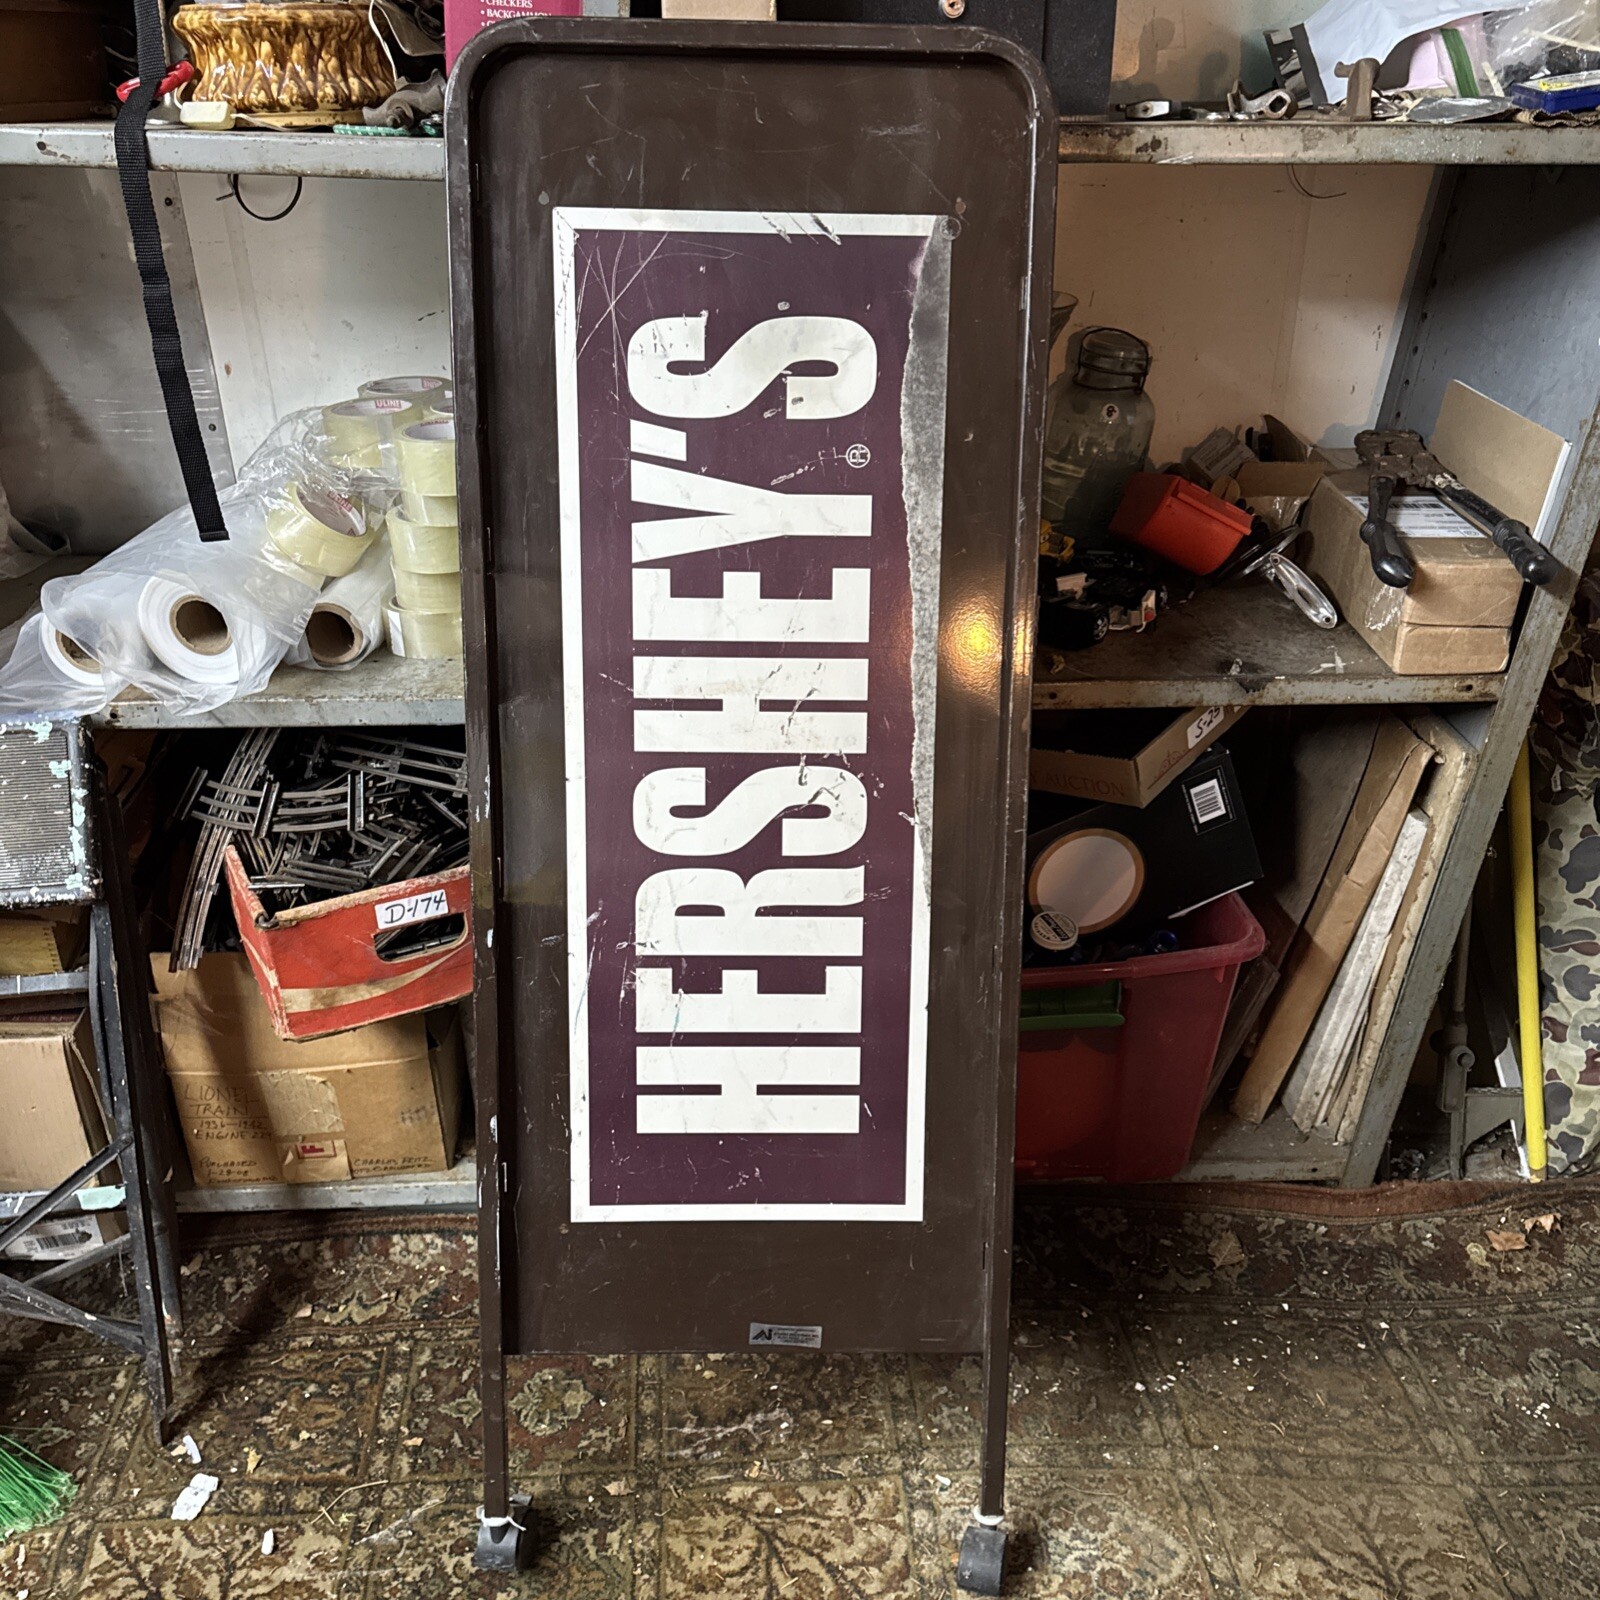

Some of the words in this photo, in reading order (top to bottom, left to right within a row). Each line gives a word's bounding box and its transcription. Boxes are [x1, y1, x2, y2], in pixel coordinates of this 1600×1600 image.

[486, 0, 533, 8] CHECKERS
[627, 316, 877, 1133] HERSHEY'S
[1045, 772, 1125, 797] AUCTION
[384, 892, 445, 924] D-174
[184, 1084, 260, 1104] LIONEL
[189, 1103, 248, 1118] TRAIN
[195, 1130, 247, 1140] ENGINE
